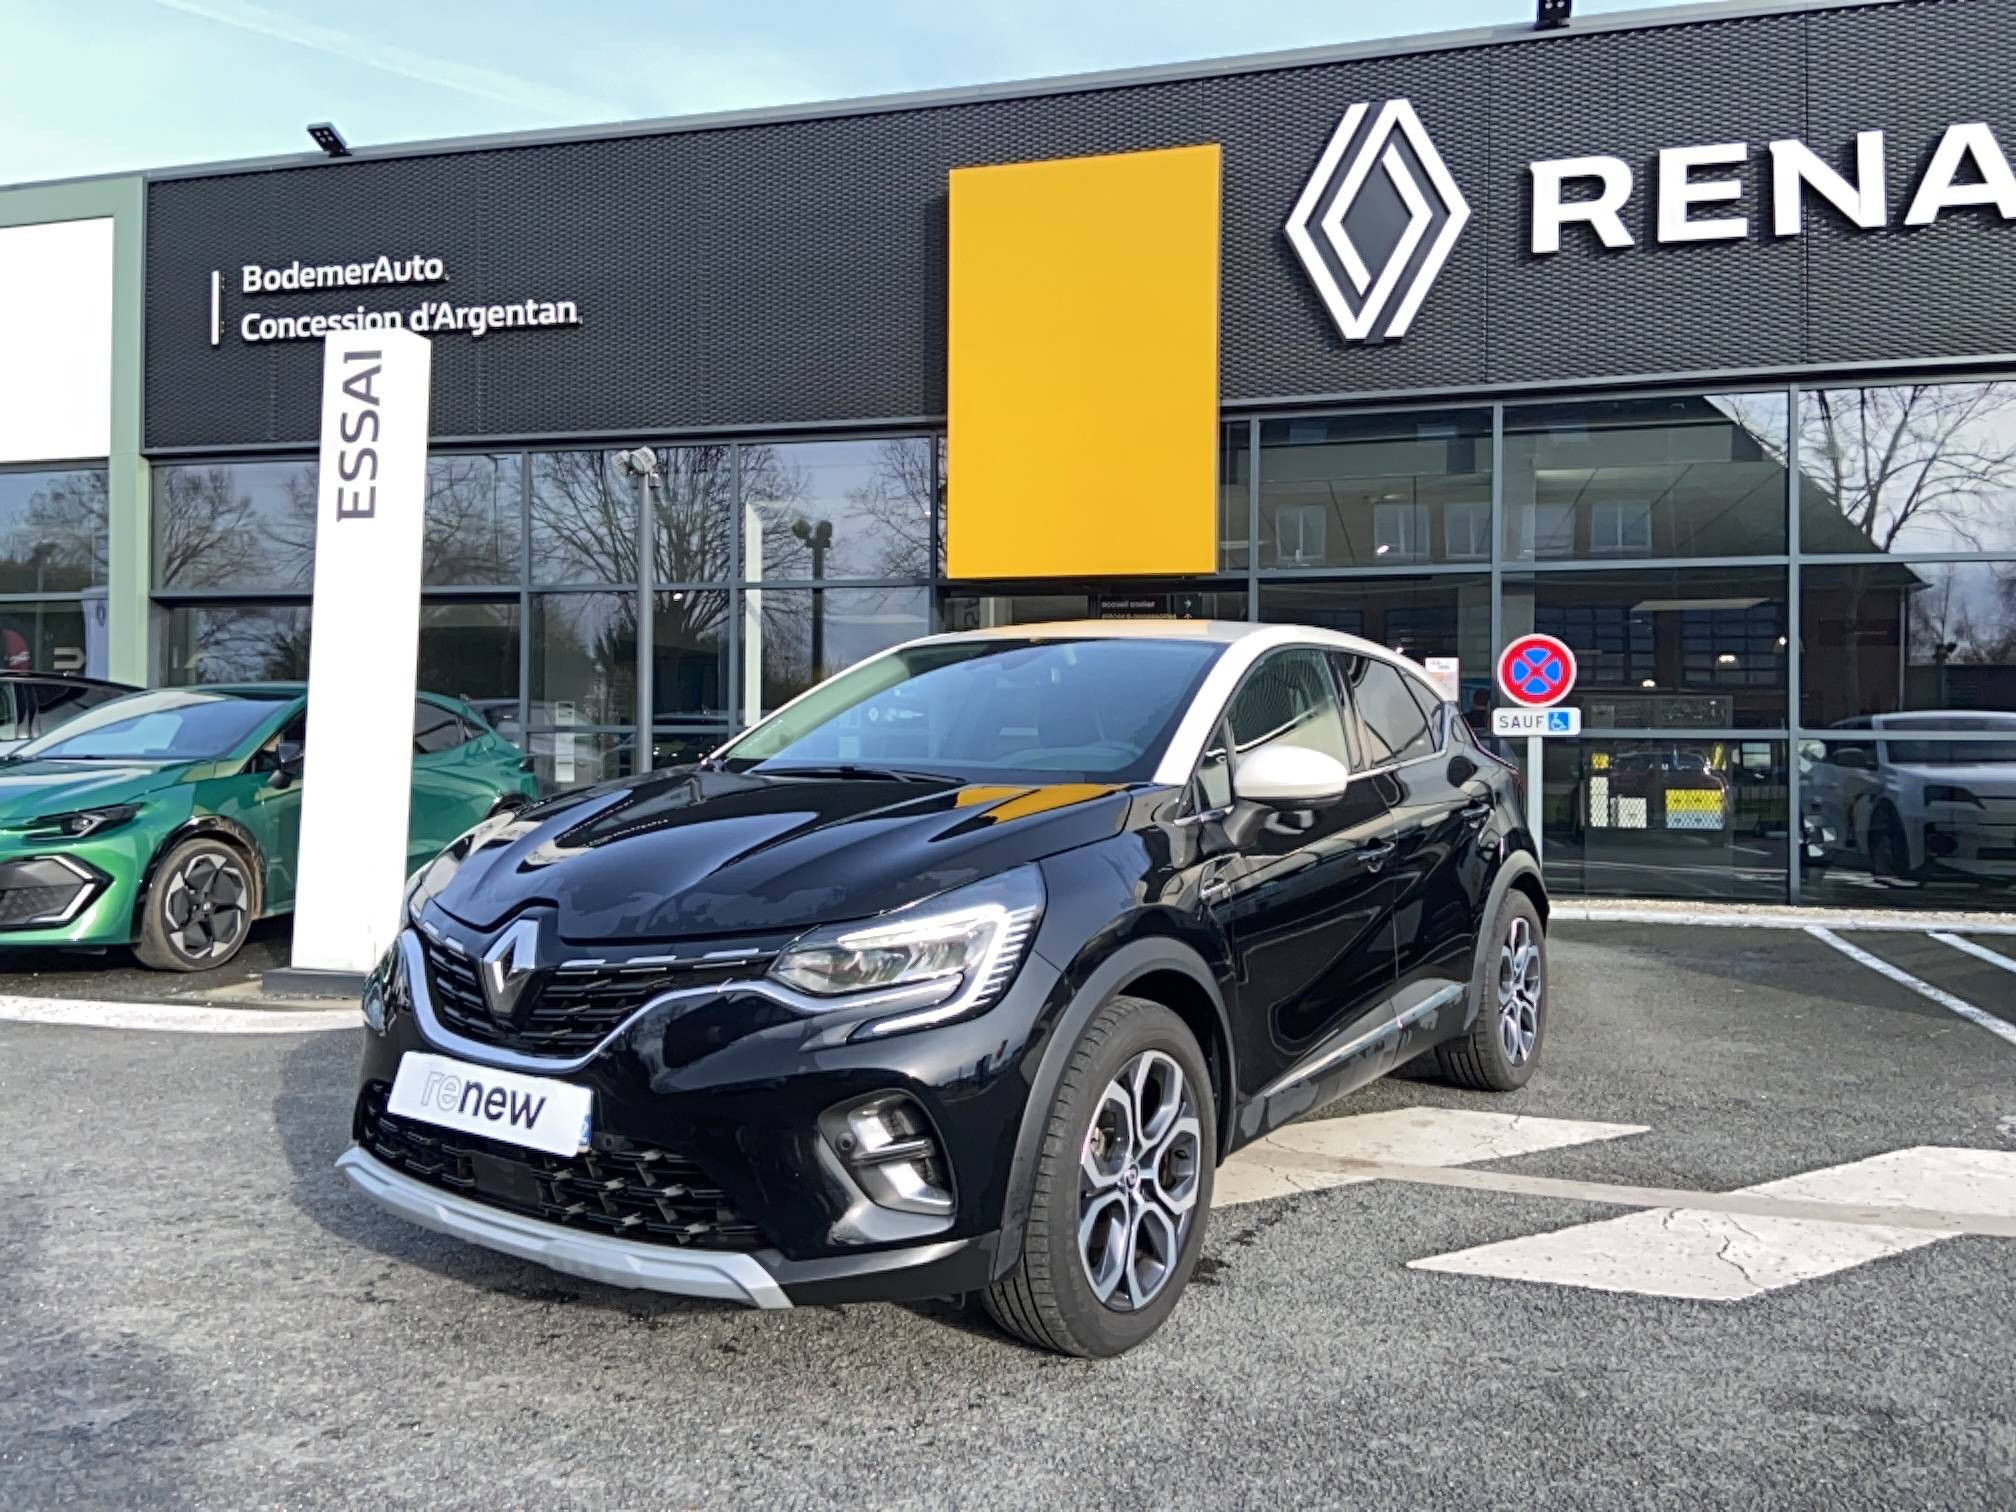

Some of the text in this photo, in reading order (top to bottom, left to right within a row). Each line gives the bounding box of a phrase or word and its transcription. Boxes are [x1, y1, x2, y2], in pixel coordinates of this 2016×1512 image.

[1530, 121, 2016, 254] RENA
[241, 254, 444, 293] BodemerAuto
[241, 298, 577, 341] Concession d'Argentan
[336, 350, 383, 523] ESSAI
[1499, 715, 1546, 729] SAUF
[420, 1071, 547, 1130] renew
